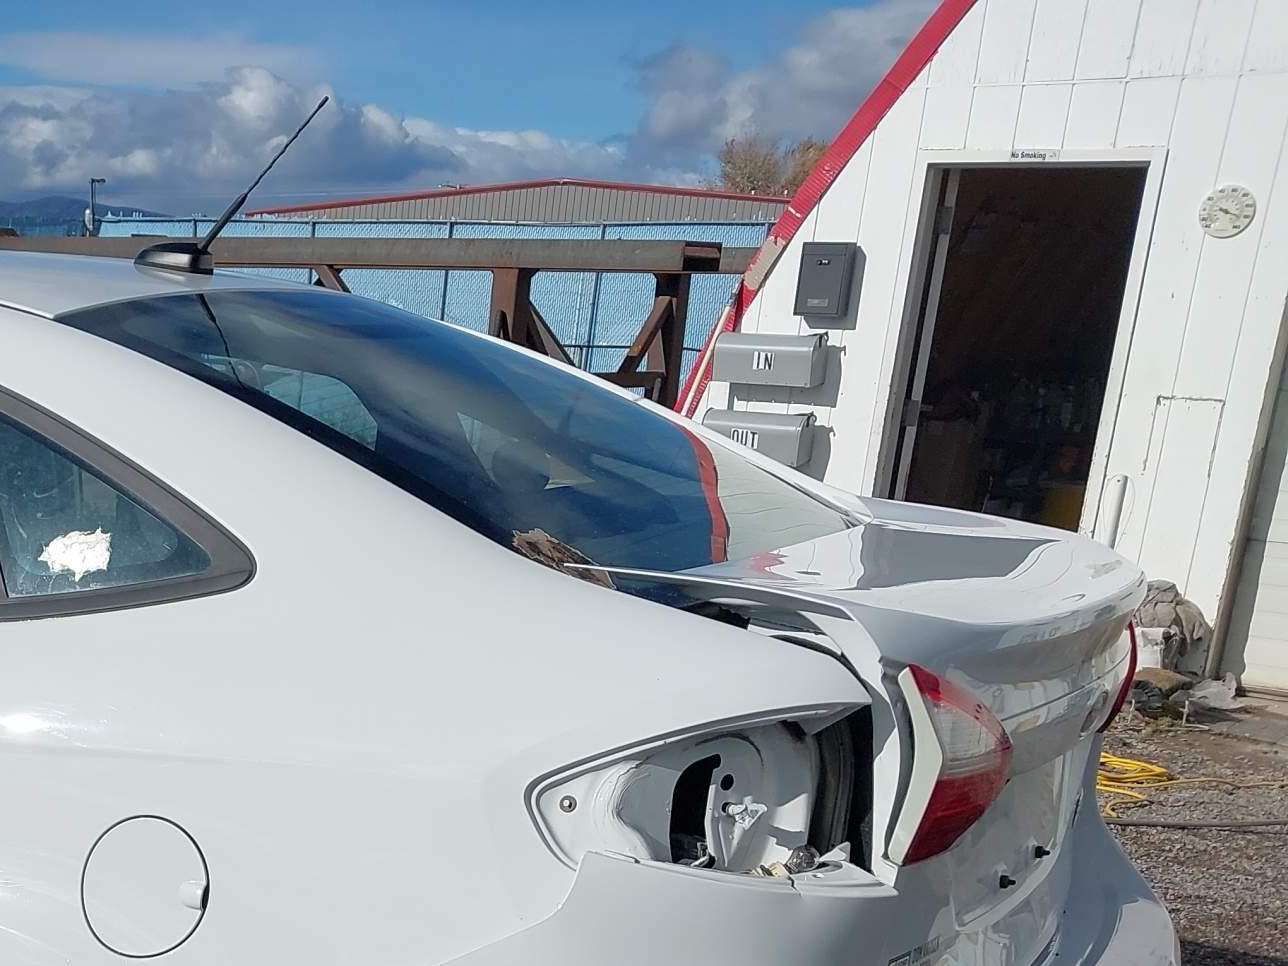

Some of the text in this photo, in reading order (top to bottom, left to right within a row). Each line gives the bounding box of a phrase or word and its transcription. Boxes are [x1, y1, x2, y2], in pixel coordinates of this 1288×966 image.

[1011, 151, 1047, 161] No Smoking
[756, 352, 773, 370] IN
[731, 429, 758, 448] OUT
